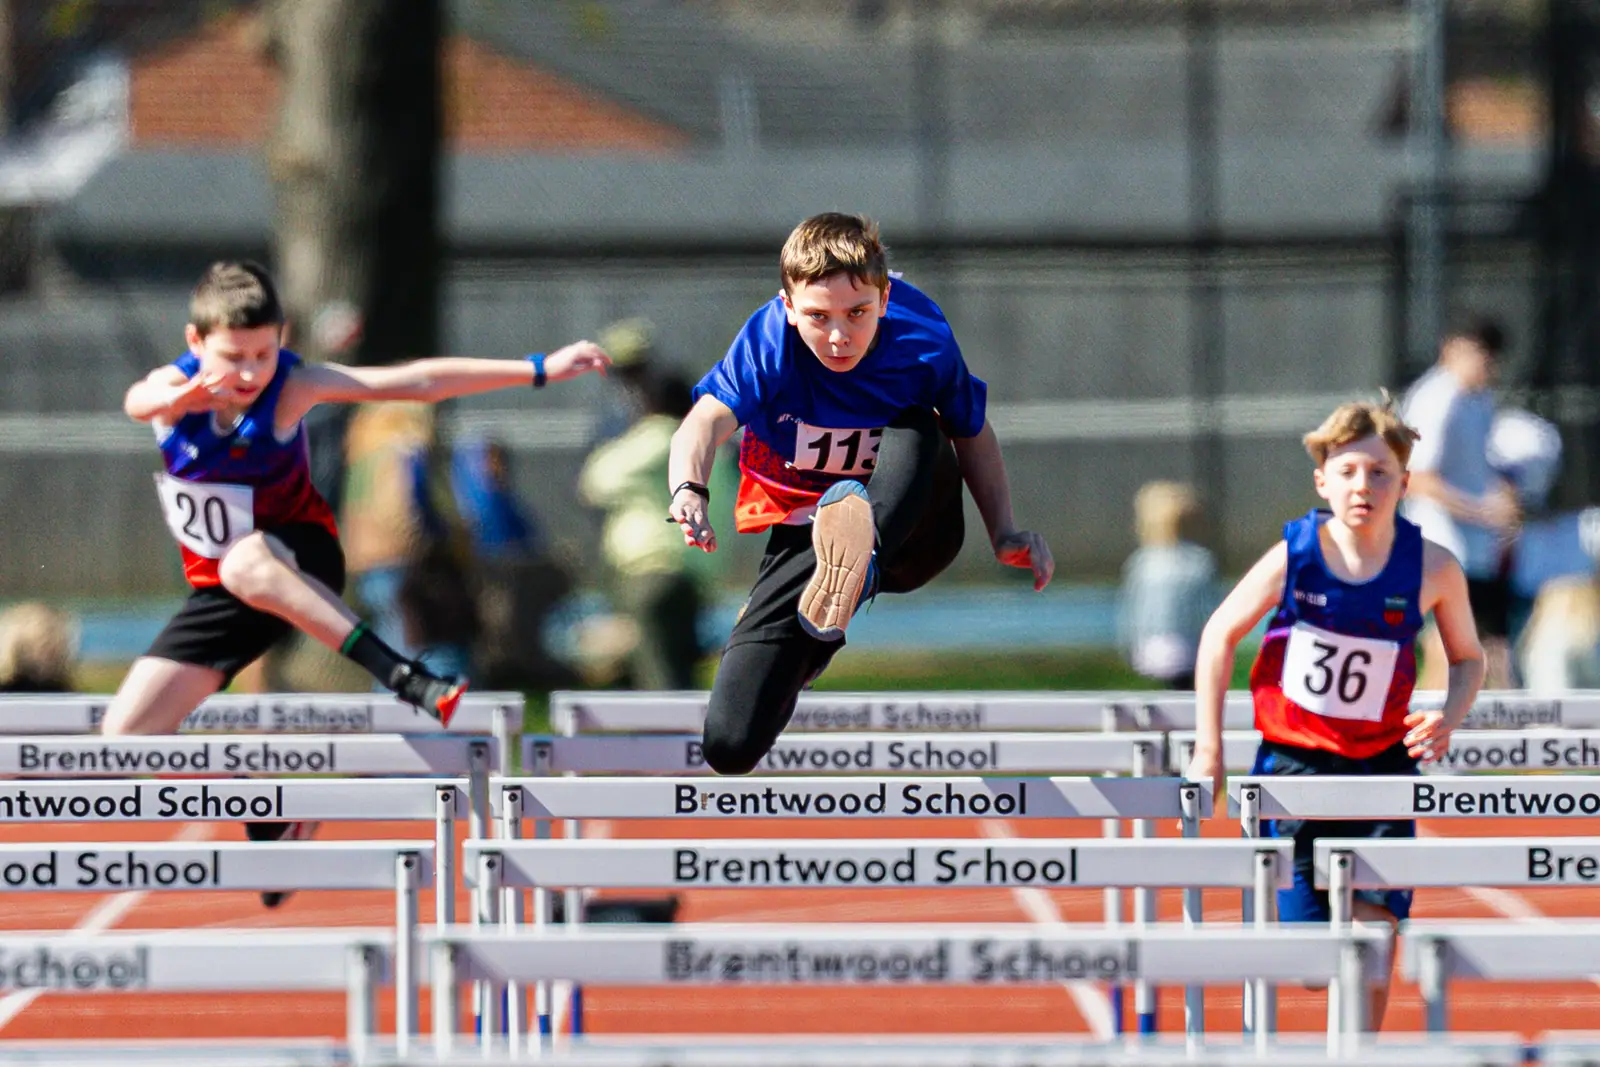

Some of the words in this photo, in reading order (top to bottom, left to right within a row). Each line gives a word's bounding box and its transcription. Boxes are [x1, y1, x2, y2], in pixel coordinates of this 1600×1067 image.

[176, 492, 230, 545] 20
[1304, 639, 1372, 704] 36
[271, 703, 373, 730] School
[883, 703, 984, 728] School
[20, 743, 209, 770] Brentwood
[224, 742, 335, 771] School
[686, 741, 873, 768] Btwood
[888, 741, 997, 769] School
[0, 785, 141, 817] ntwood
[158, 785, 283, 817] School
[675, 783, 886, 815] Brentwood
[902, 783, 1026, 815] School
[1413, 783, 1600, 814] Brentwoo
[77, 851, 220, 886] School
[675, 848, 915, 883] Brentwood
[936, 848, 1077, 883] School
[1528, 848, 1598, 881] Bre
[664, 940, 948, 981] Brentwood
[972, 940, 1138, 982] School
